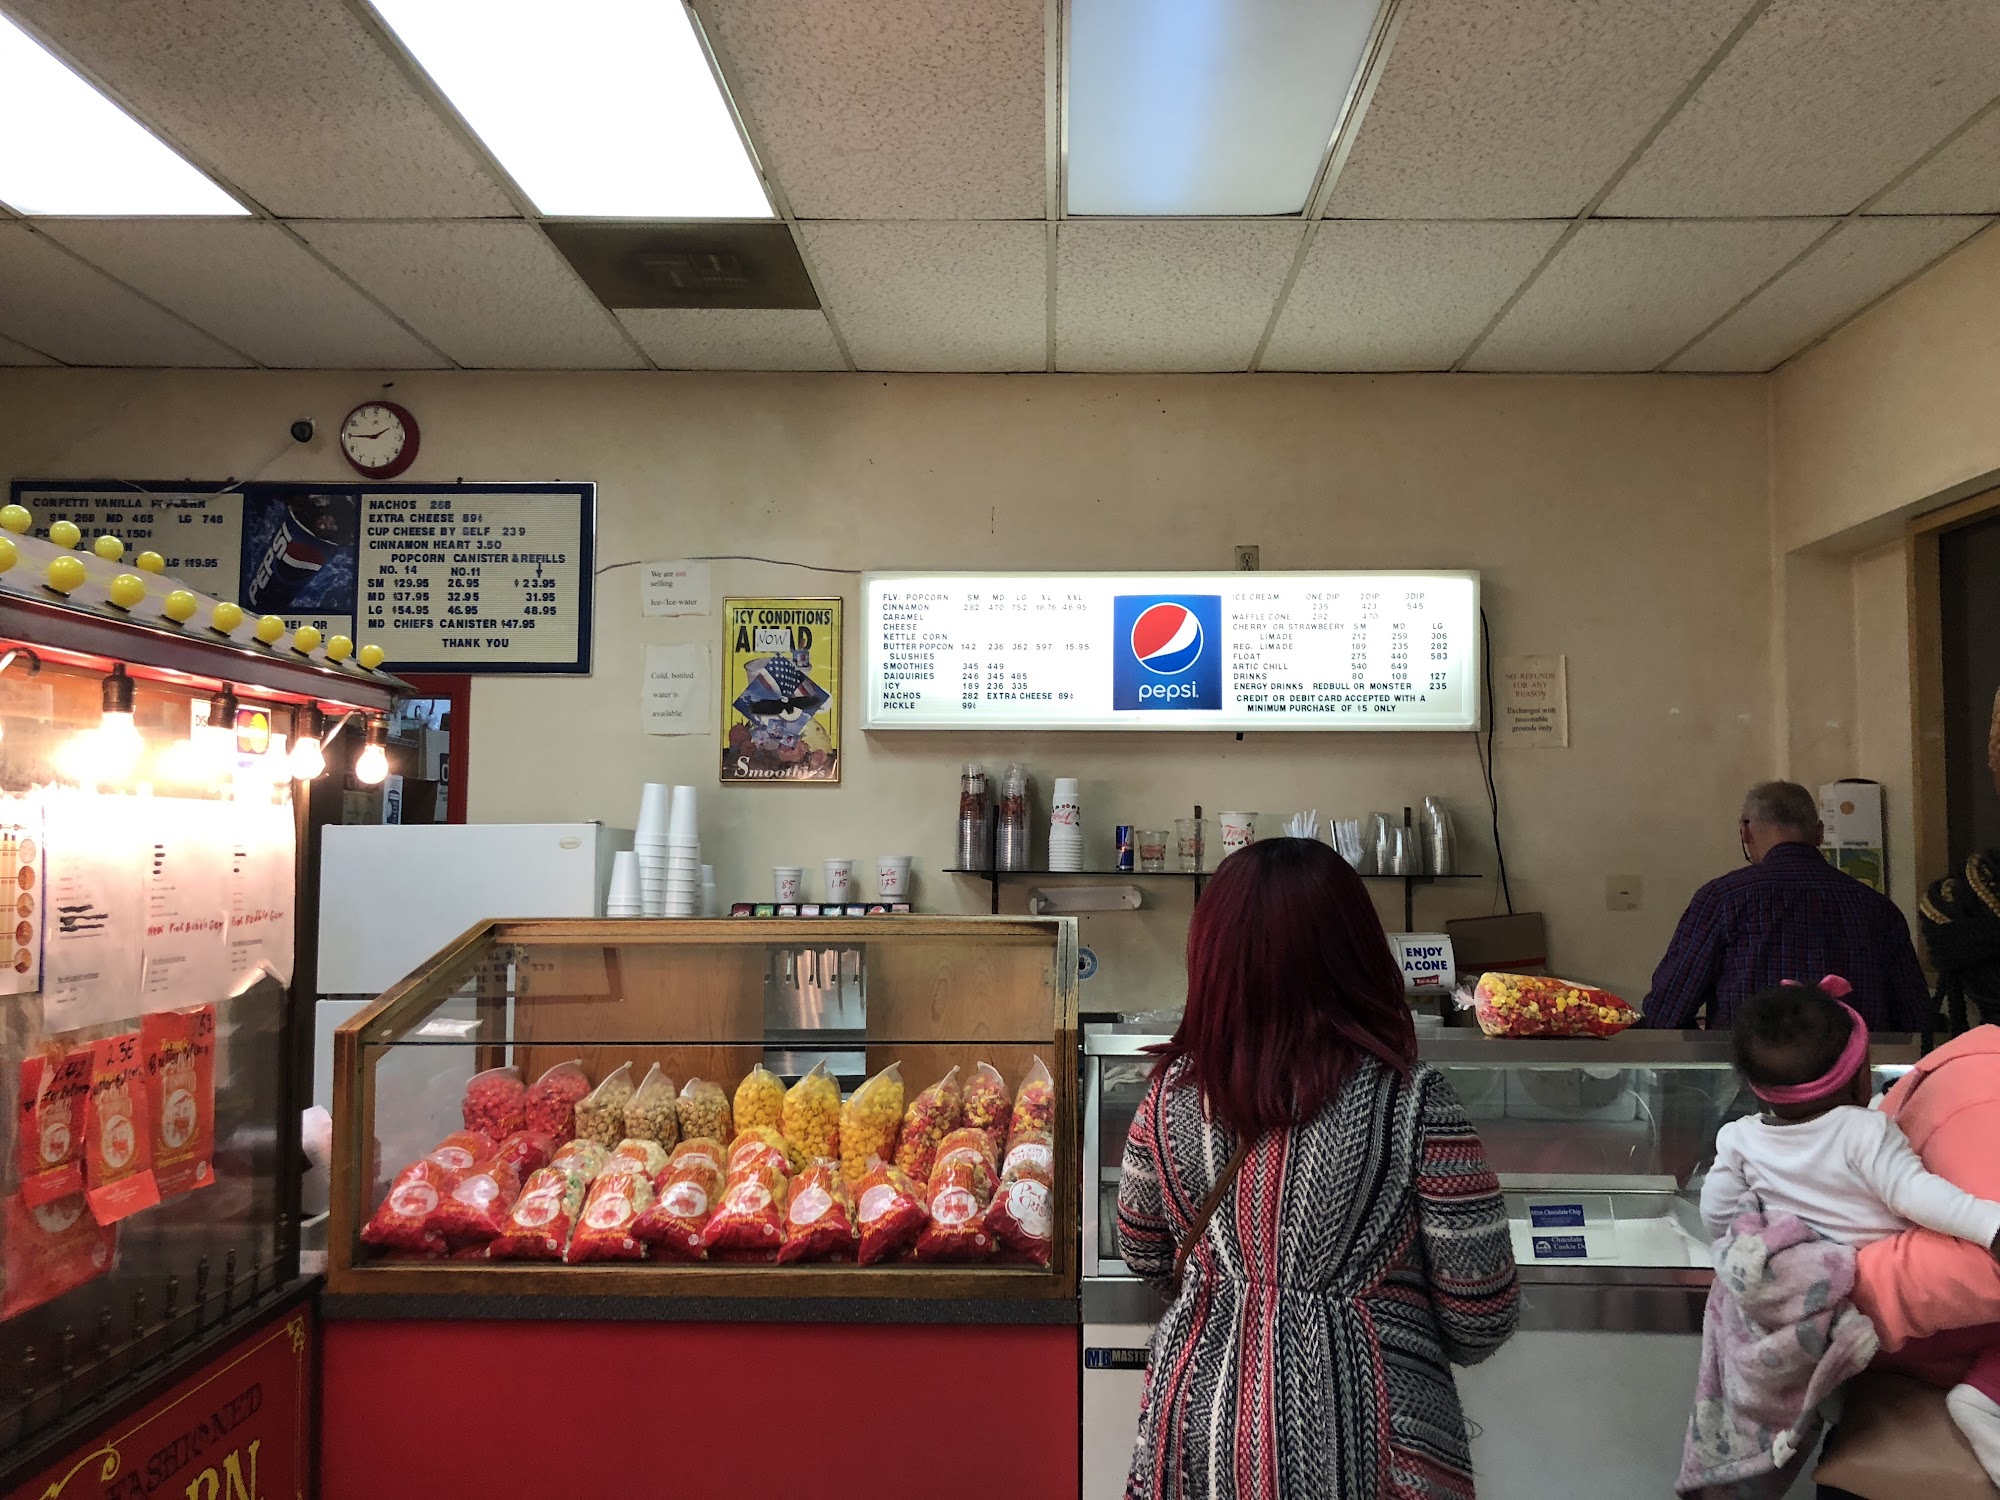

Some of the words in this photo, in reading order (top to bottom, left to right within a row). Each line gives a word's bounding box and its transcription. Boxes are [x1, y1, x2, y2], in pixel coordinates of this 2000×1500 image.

[32, 498, 89, 508] CONFETTI
[95, 498, 142, 508] VANILLA
[369, 500, 417, 510] NACHOS
[106, 513, 123, 523] MD
[178, 513, 192, 523] LG
[369, 514, 405, 523] EXTRA
[409, 514, 455, 523] CHEESE
[367, 527, 389, 536] CUP
[393, 527, 436, 536] CHEESE
[440, 527, 456, 536] BY
[462, 527, 490, 536] SELF
[369, 540, 428, 549] CINNAMON
[433, 540, 470, 549] HEART
[476, 540, 502, 549] 3.50
[166, 558, 179, 567] LG
[391, 554, 446, 563] POPCORN
[453, 554, 509, 563] CANISTER
[249, 521, 292, 606] PEPSI
[380, 565, 398, 575] NO.
[405, 565, 417, 575] 14
[367, 579, 384, 588] SM
[448, 579, 480, 588] 26.95
[651, 580, 673, 588] selling
[368, 592, 385, 601] MD
[448, 592, 480, 601] 32.95
[526, 592, 556, 601] 31.95
[368, 606, 383, 615] LG
[448, 606, 478, 615] 46.95
[524, 606, 557, 615] 48.95
[735, 610, 754, 625] ICY
[758, 610, 830, 625] CONDITIONS
[313, 620, 328, 629] OR
[368, 619, 385, 629] MD
[394, 619, 434, 629] CHIEFS
[440, 619, 497, 629] CANISTER
[883, 623, 918, 631] CHEESE
[757, 630, 787, 647] NOW
[1260, 633, 1293, 641] LIMADE
[1431, 633, 1448, 641] 306
[442, 639, 480, 648] THANK
[486, 639, 510, 648] YOU
[884, 672, 935, 680] DAIQUIRIES
[885, 682, 900, 690] ICY
[963, 682, 980, 690] 189
[987, 682, 1004, 690] 236
[1012, 682, 1028, 690] 335
[883, 692, 921, 700] NACHOS
[962, 692, 979, 700] 282
[987, 692, 1017, 700] EXTRA
[1019, 692, 1053, 700] CHEESE
[1138, 681, 1196, 702] pepsi
[1236, 694, 1268, 702] CREDIT
[1272, 694, 1285, 702] OR
[1289, 694, 1315, 702] DEBIT
[1317, 694, 1342, 702] CARD
[1344, 694, 1390, 702] ACCEPTED
[1393, 694, 1416, 702] WITH
[1420, 694, 1426, 702] A
[883, 702, 916, 710] PICKLE
[1247, 704, 1287, 712] MINIMUM
[1289, 704, 1335, 712] PURCHASE
[1341, 704, 1352, 712] OF
[1374, 704, 1396, 712] ONLY
[1512, 725, 1537, 733] grounds
[1539, 725, 1553, 733] only
[734, 756, 826, 778] Smoothies
[1406, 947, 1443, 959] ENJOY
[1404, 961, 1414, 970] A
[1414, 961, 1448, 970] CONE
